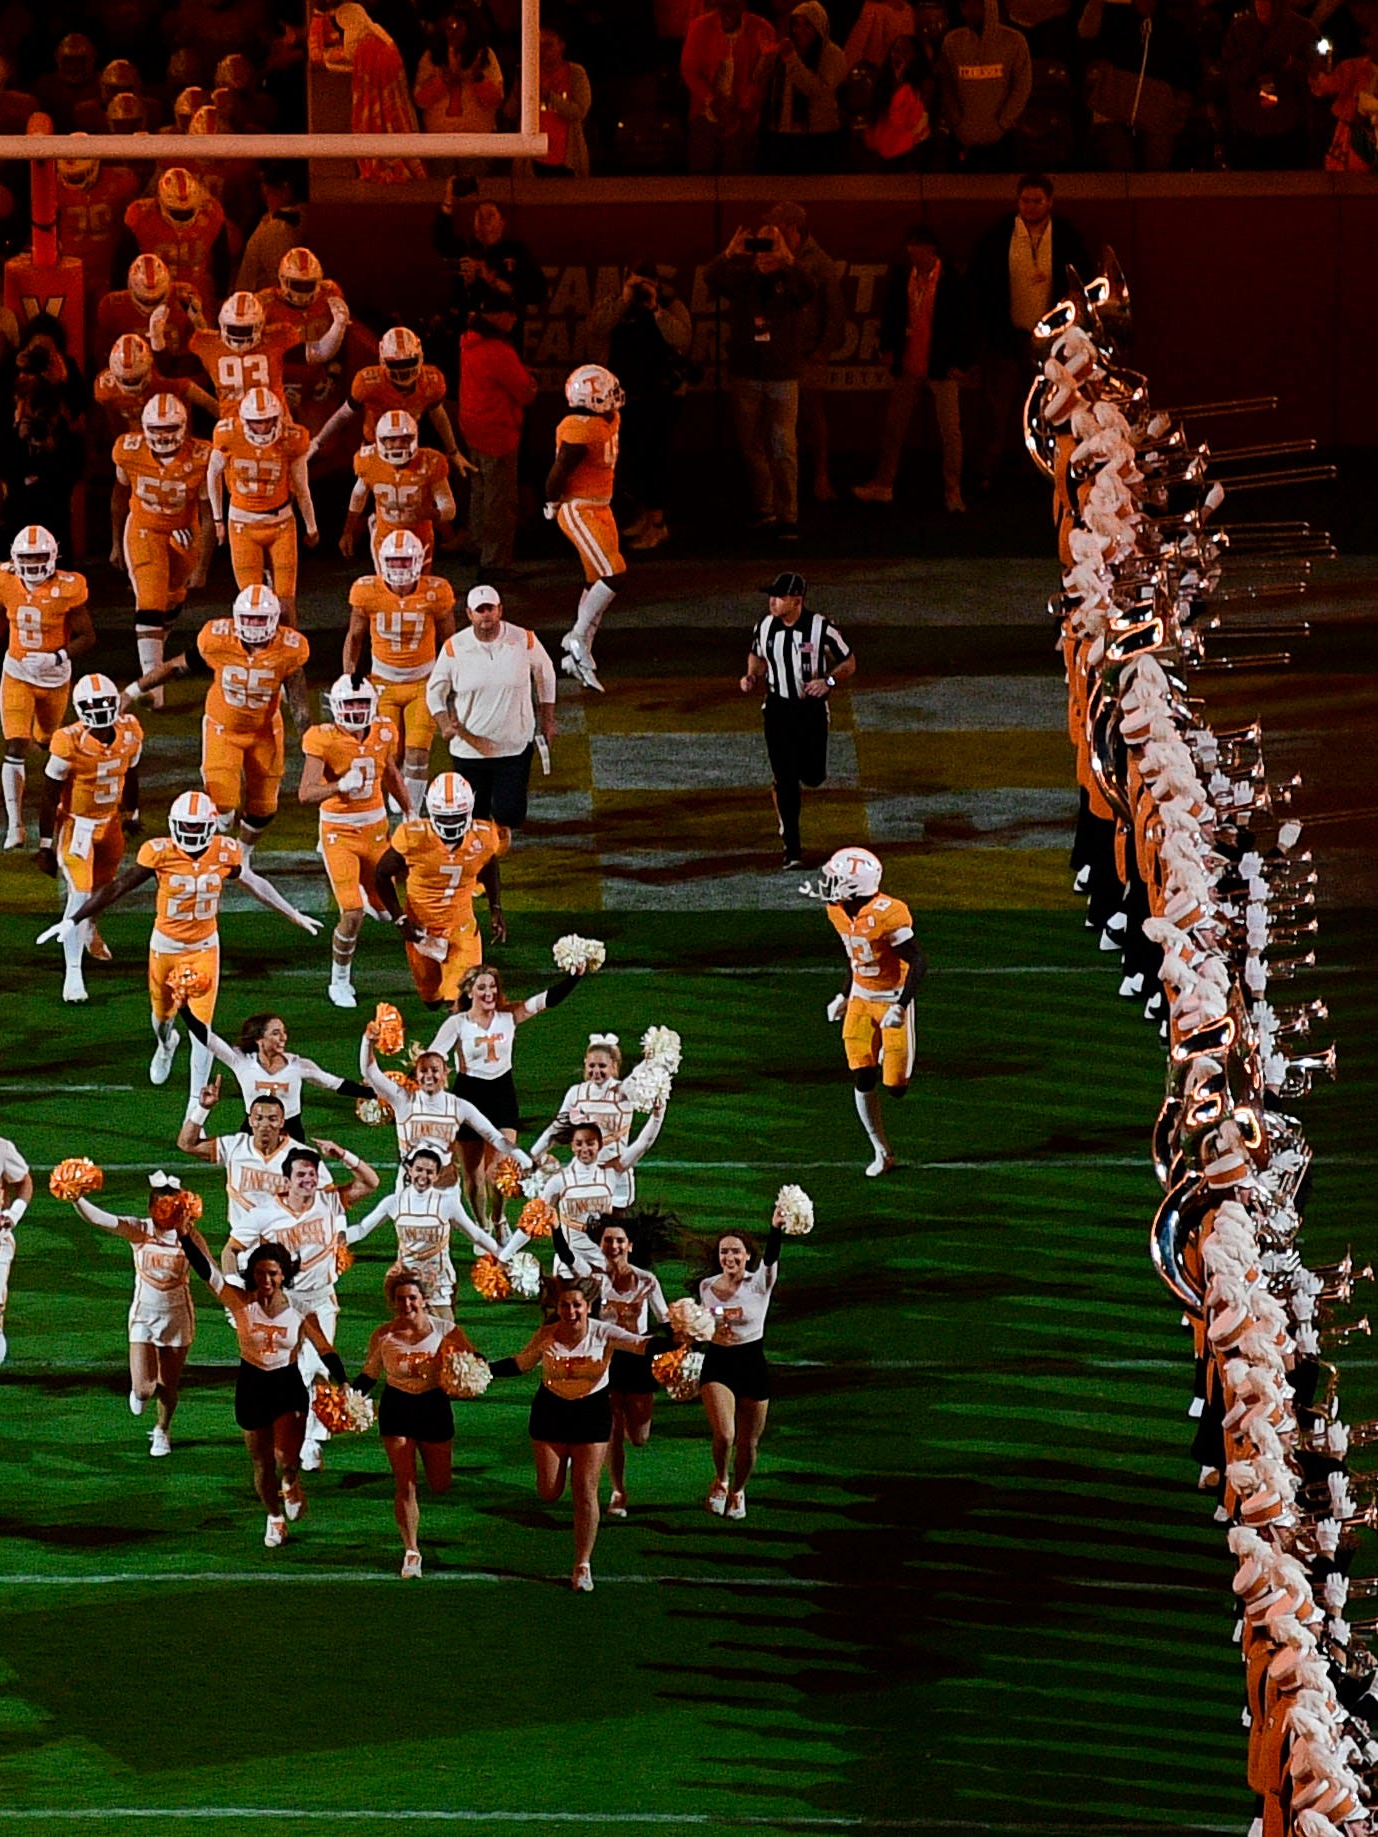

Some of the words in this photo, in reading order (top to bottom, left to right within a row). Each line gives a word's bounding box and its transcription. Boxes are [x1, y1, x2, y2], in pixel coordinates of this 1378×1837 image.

[217, 354, 270, 397] 93
[582, 375, 601, 395] T
[17, 605, 44, 650] 8
[374, 611, 426, 653] 47
[221, 664, 275, 709] 65
[93, 757, 124, 805] 5
[438, 864, 464, 906] 7
[846, 857, 865, 875] T
[166, 873, 224, 921] 26
[474, 1034, 504, 1063] T
[252, 1323, 287, 1354] T
